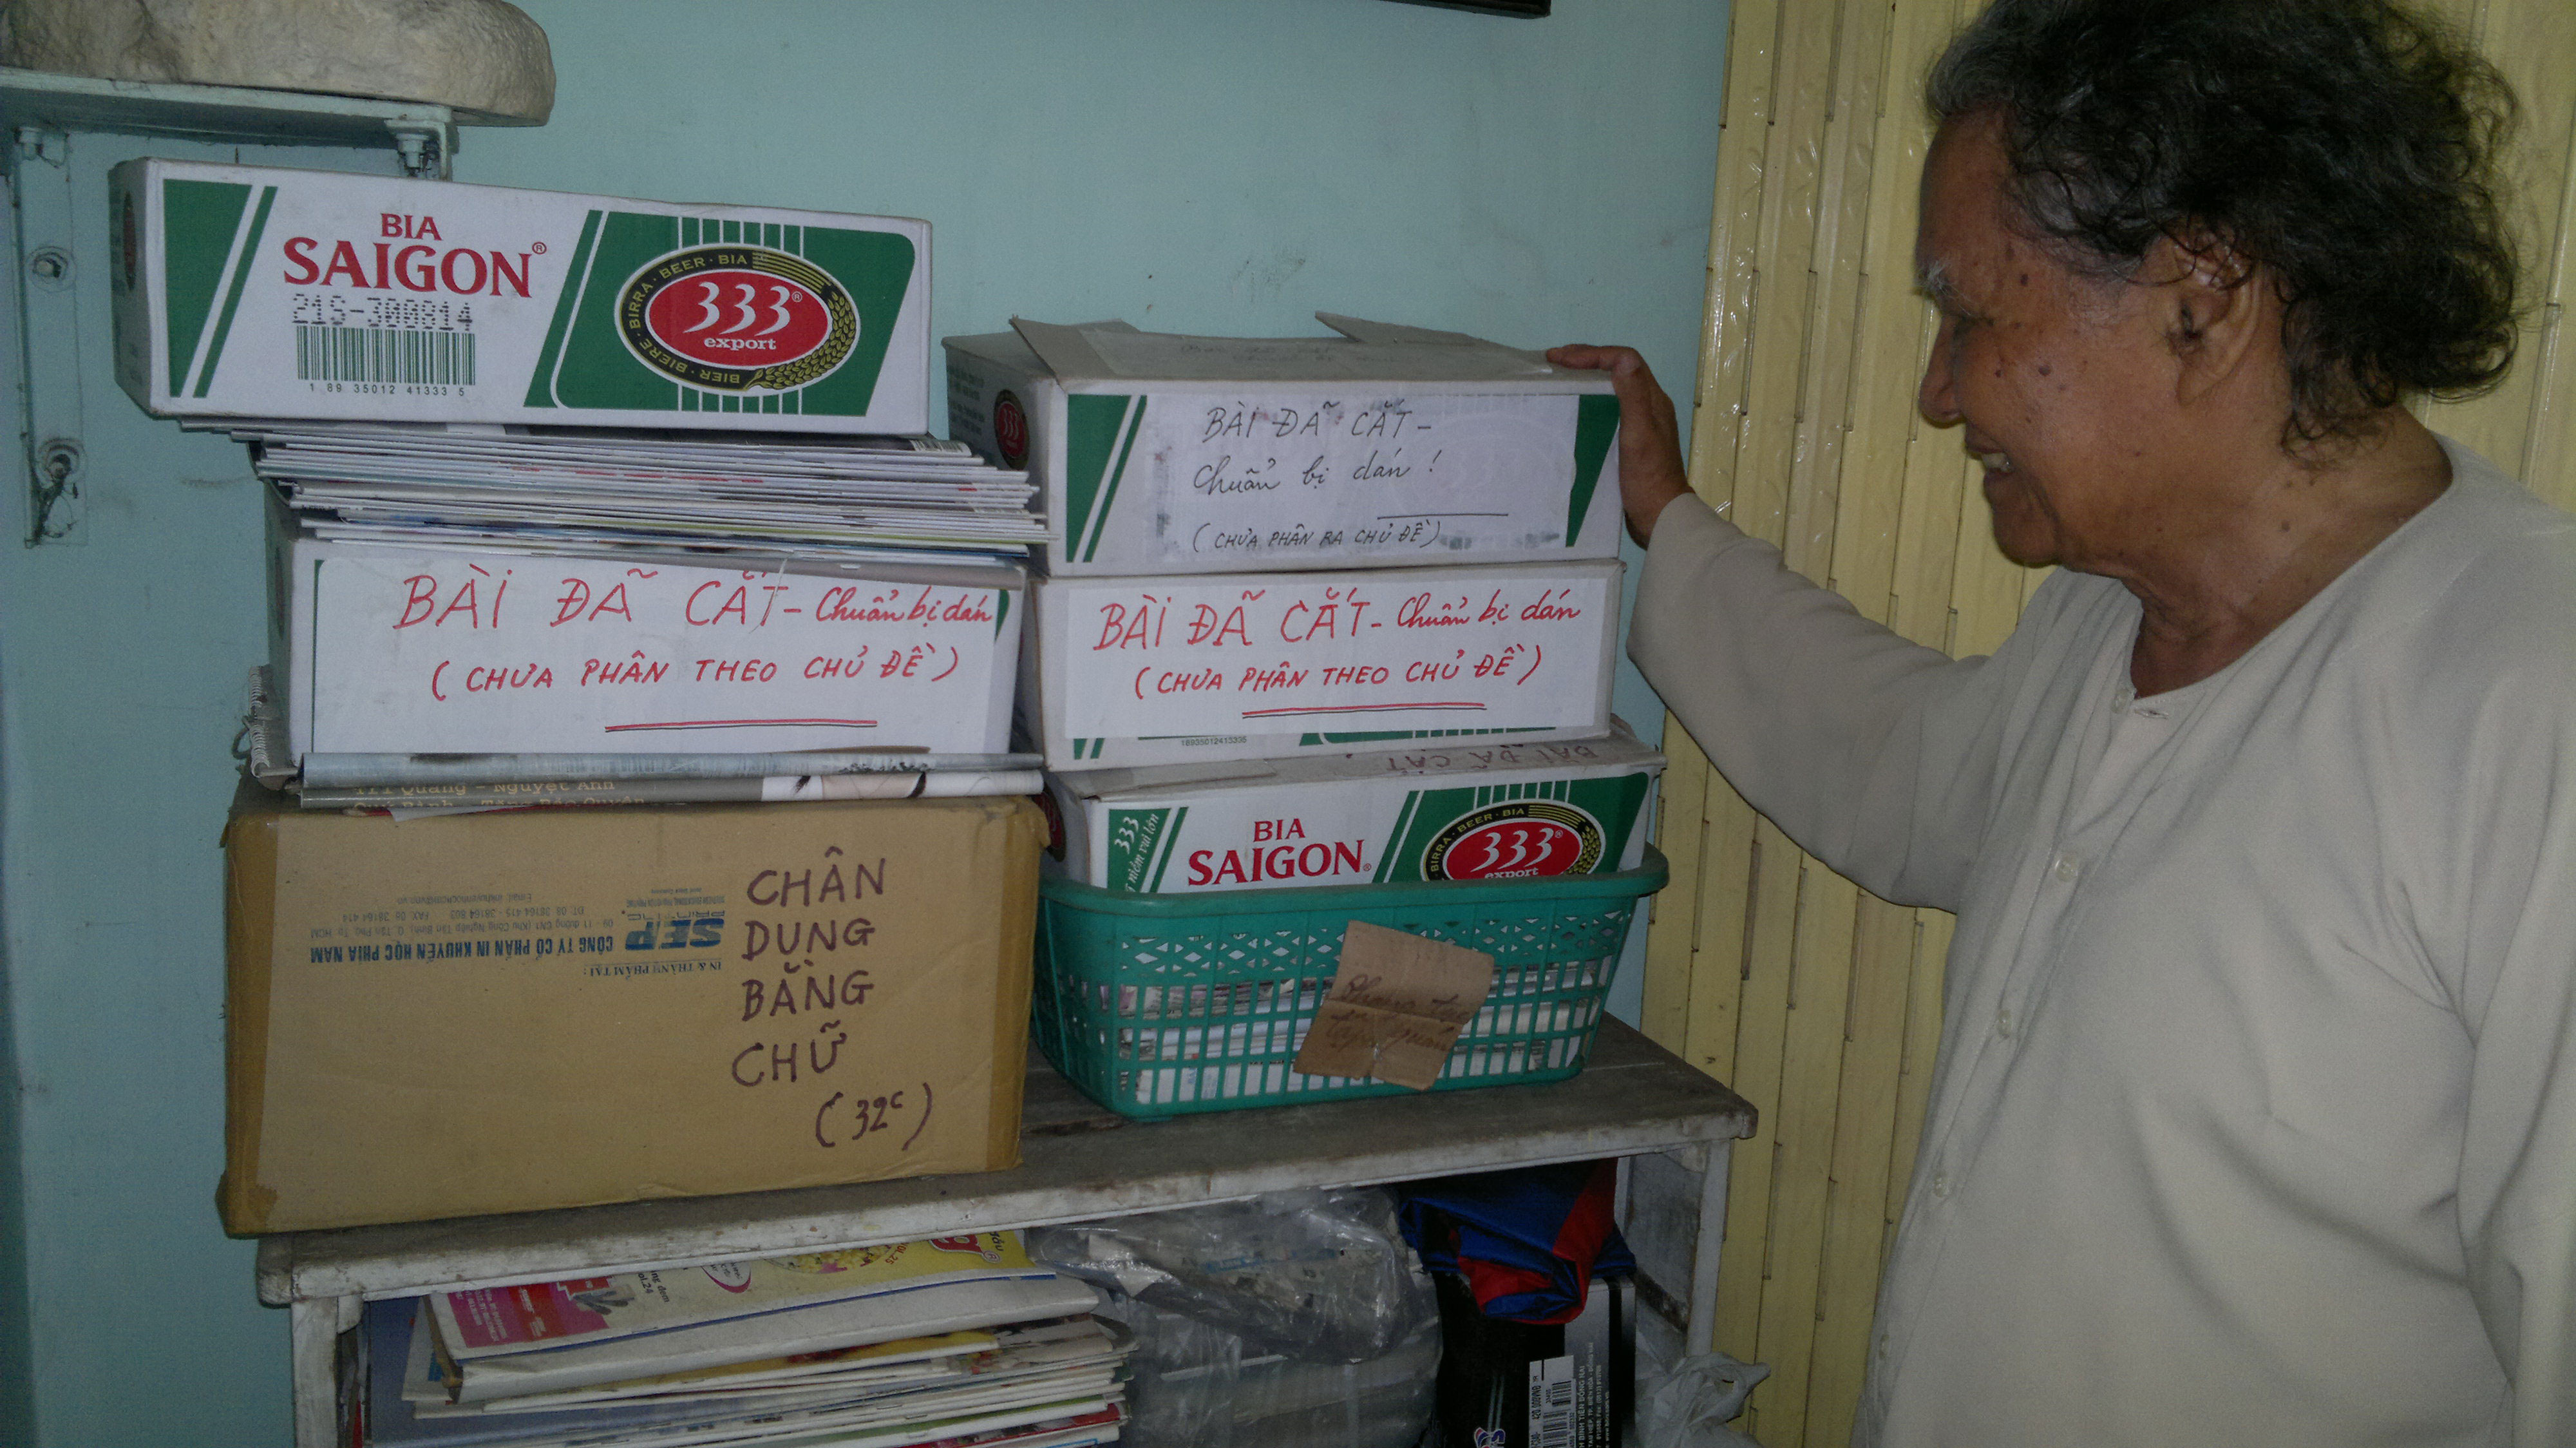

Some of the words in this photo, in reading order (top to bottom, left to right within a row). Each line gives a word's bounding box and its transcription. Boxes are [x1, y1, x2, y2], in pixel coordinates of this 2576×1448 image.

[380, 213, 442, 241] BIA
[283, 236, 533, 298] SAIGON
[629, 282, 653, 329] BIRRA
[659, 256, 705, 280] BEER
[718, 254, 748, 265] BIA
[683, 281, 791, 336] 333
[639, 339, 688, 374] BIERE
[704, 336, 777, 350] export
[699, 368, 740, 384] BIER
[1202, 401, 1260, 443] BÀI
[1272, 401, 1340, 437] ĐÃ
[1351, 399, 1412, 439] CẮT
[1193, 455, 1280, 495] Chuẩn
[1303, 455, 1325, 490] bị
[1352, 448, 1411, 480] dán
[1268, 522, 1315, 547] PHÂN
[1320, 530, 1343, 547] RA
[1354, 521, 1395, 544] CHỦ
[392, 563, 513, 629] BÀI
[551, 567, 659, 628] ĐÃ
[816, 586, 905, 623] Chuẩn
[911, 586, 937, 627] bị
[942, 594, 994, 624] dán
[1093, 595, 1171, 651] BÀI
[1188, 589, 1266, 646] ĐÃ
[1280, 587, 1372, 644] CẮT
[1398, 592, 1472, 629] Chuẩn
[1479, 590, 1510, 628] bị
[1521, 587, 1582, 622] dán
[581, 649, 670, 687] PHÂN
[696, 658, 777, 682] THEO
[804, 645, 867, 680] CHỦ
[1239, 663, 1309, 694] PHÂN
[1323, 666, 1390, 687] THEO
[1406, 649, 1464, 684] CHỦ
[1114, 816, 1139, 855] 333
[1253, 818, 1306, 843] BIA
[1430, 837, 1452, 873] BIRRA
[1457, 812, 1493, 834] BEER
[1502, 808, 1526, 817] BIA
[1470, 827, 1555, 873] 333
[747, 846, 886, 907] CHÂN
[1188, 839, 1365, 887] SAIGON
[384, 940, 412, 962] HỌC
[417, 941, 472, 964] KHUYẾN
[477, 941, 490, 957] IN
[535, 938, 553, 960] CỔ
[579, 936, 614, 956] CÔNG
[625, 918, 724, 951] SEP
[741, 917, 875, 960] DUNG
[310, 946, 343, 964] NAM
[710, 961, 722, 971] IN
[741, 958, 875, 1022] BẰNG
[731, 1020, 848, 1087] CHỮ
[638, 1272, 654, 1294] ol.24
